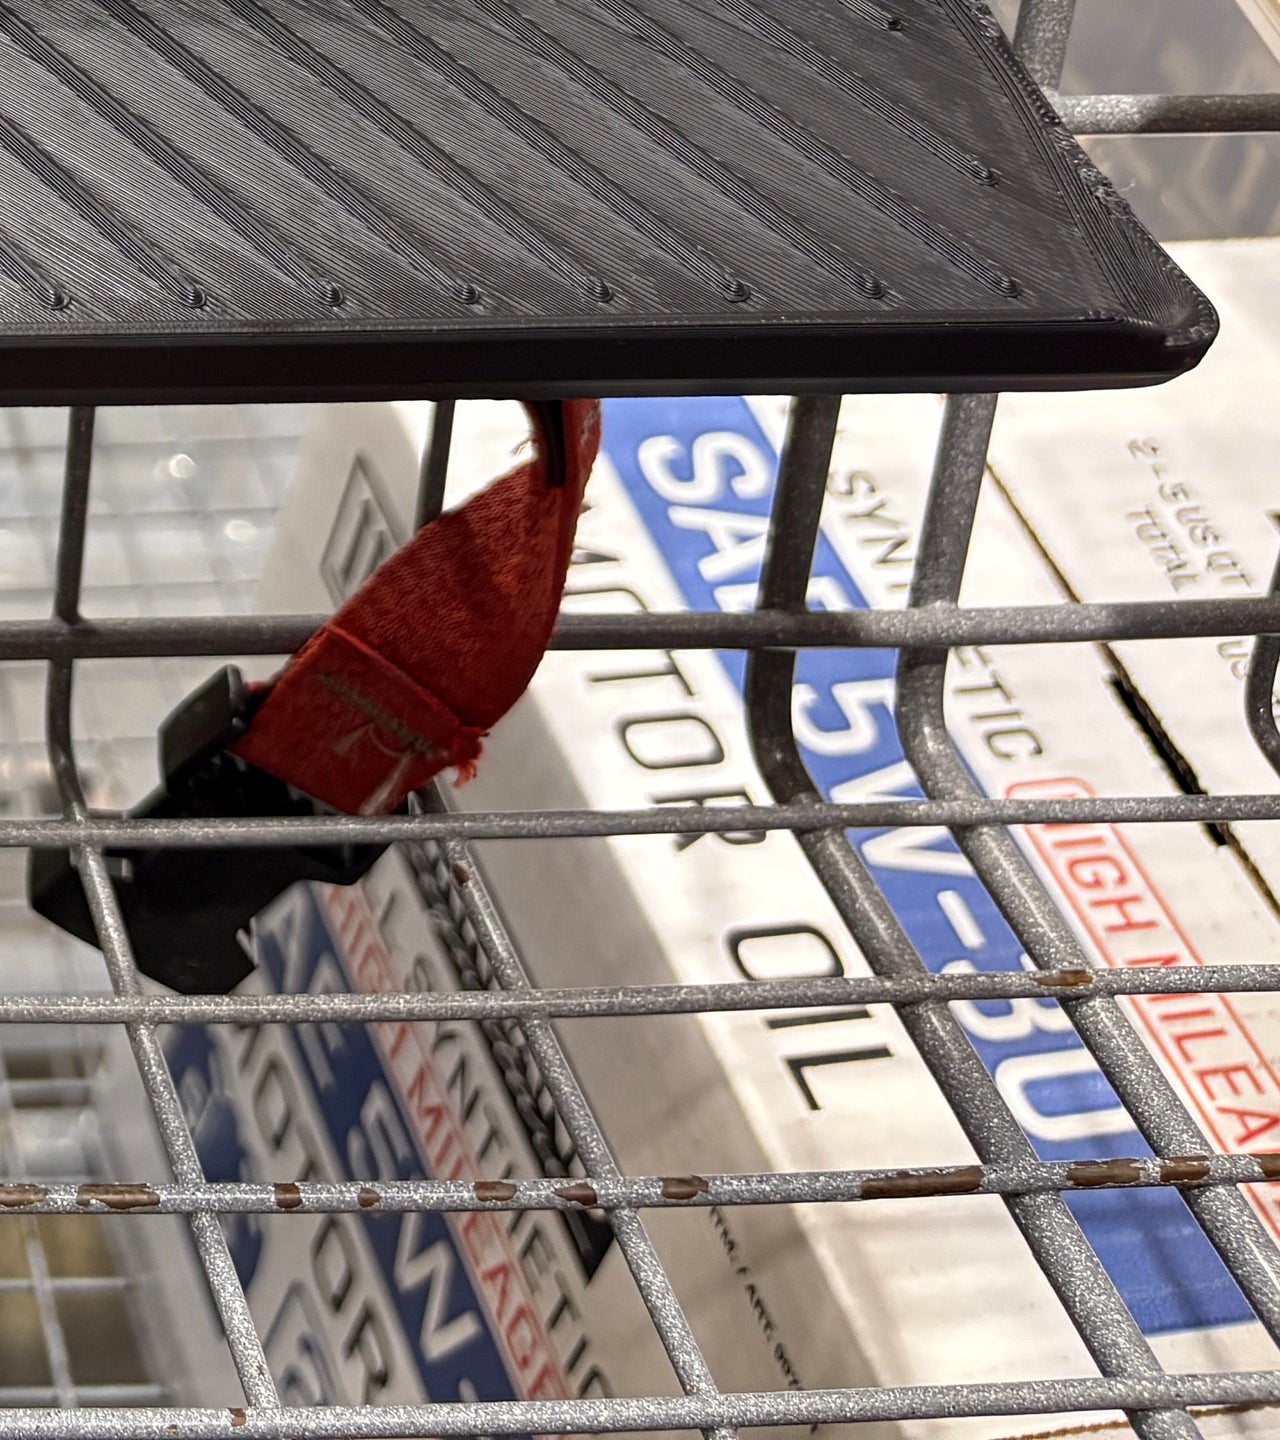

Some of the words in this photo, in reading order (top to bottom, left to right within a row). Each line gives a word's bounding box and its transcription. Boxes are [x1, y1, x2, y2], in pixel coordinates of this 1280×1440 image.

[826, 470, 1043, 759] SYNETIC
[1124, 505, 1200, 594] TOTAL
[571, 502, 768, 854] OTOR
[721, 923, 895, 1112] OIL
